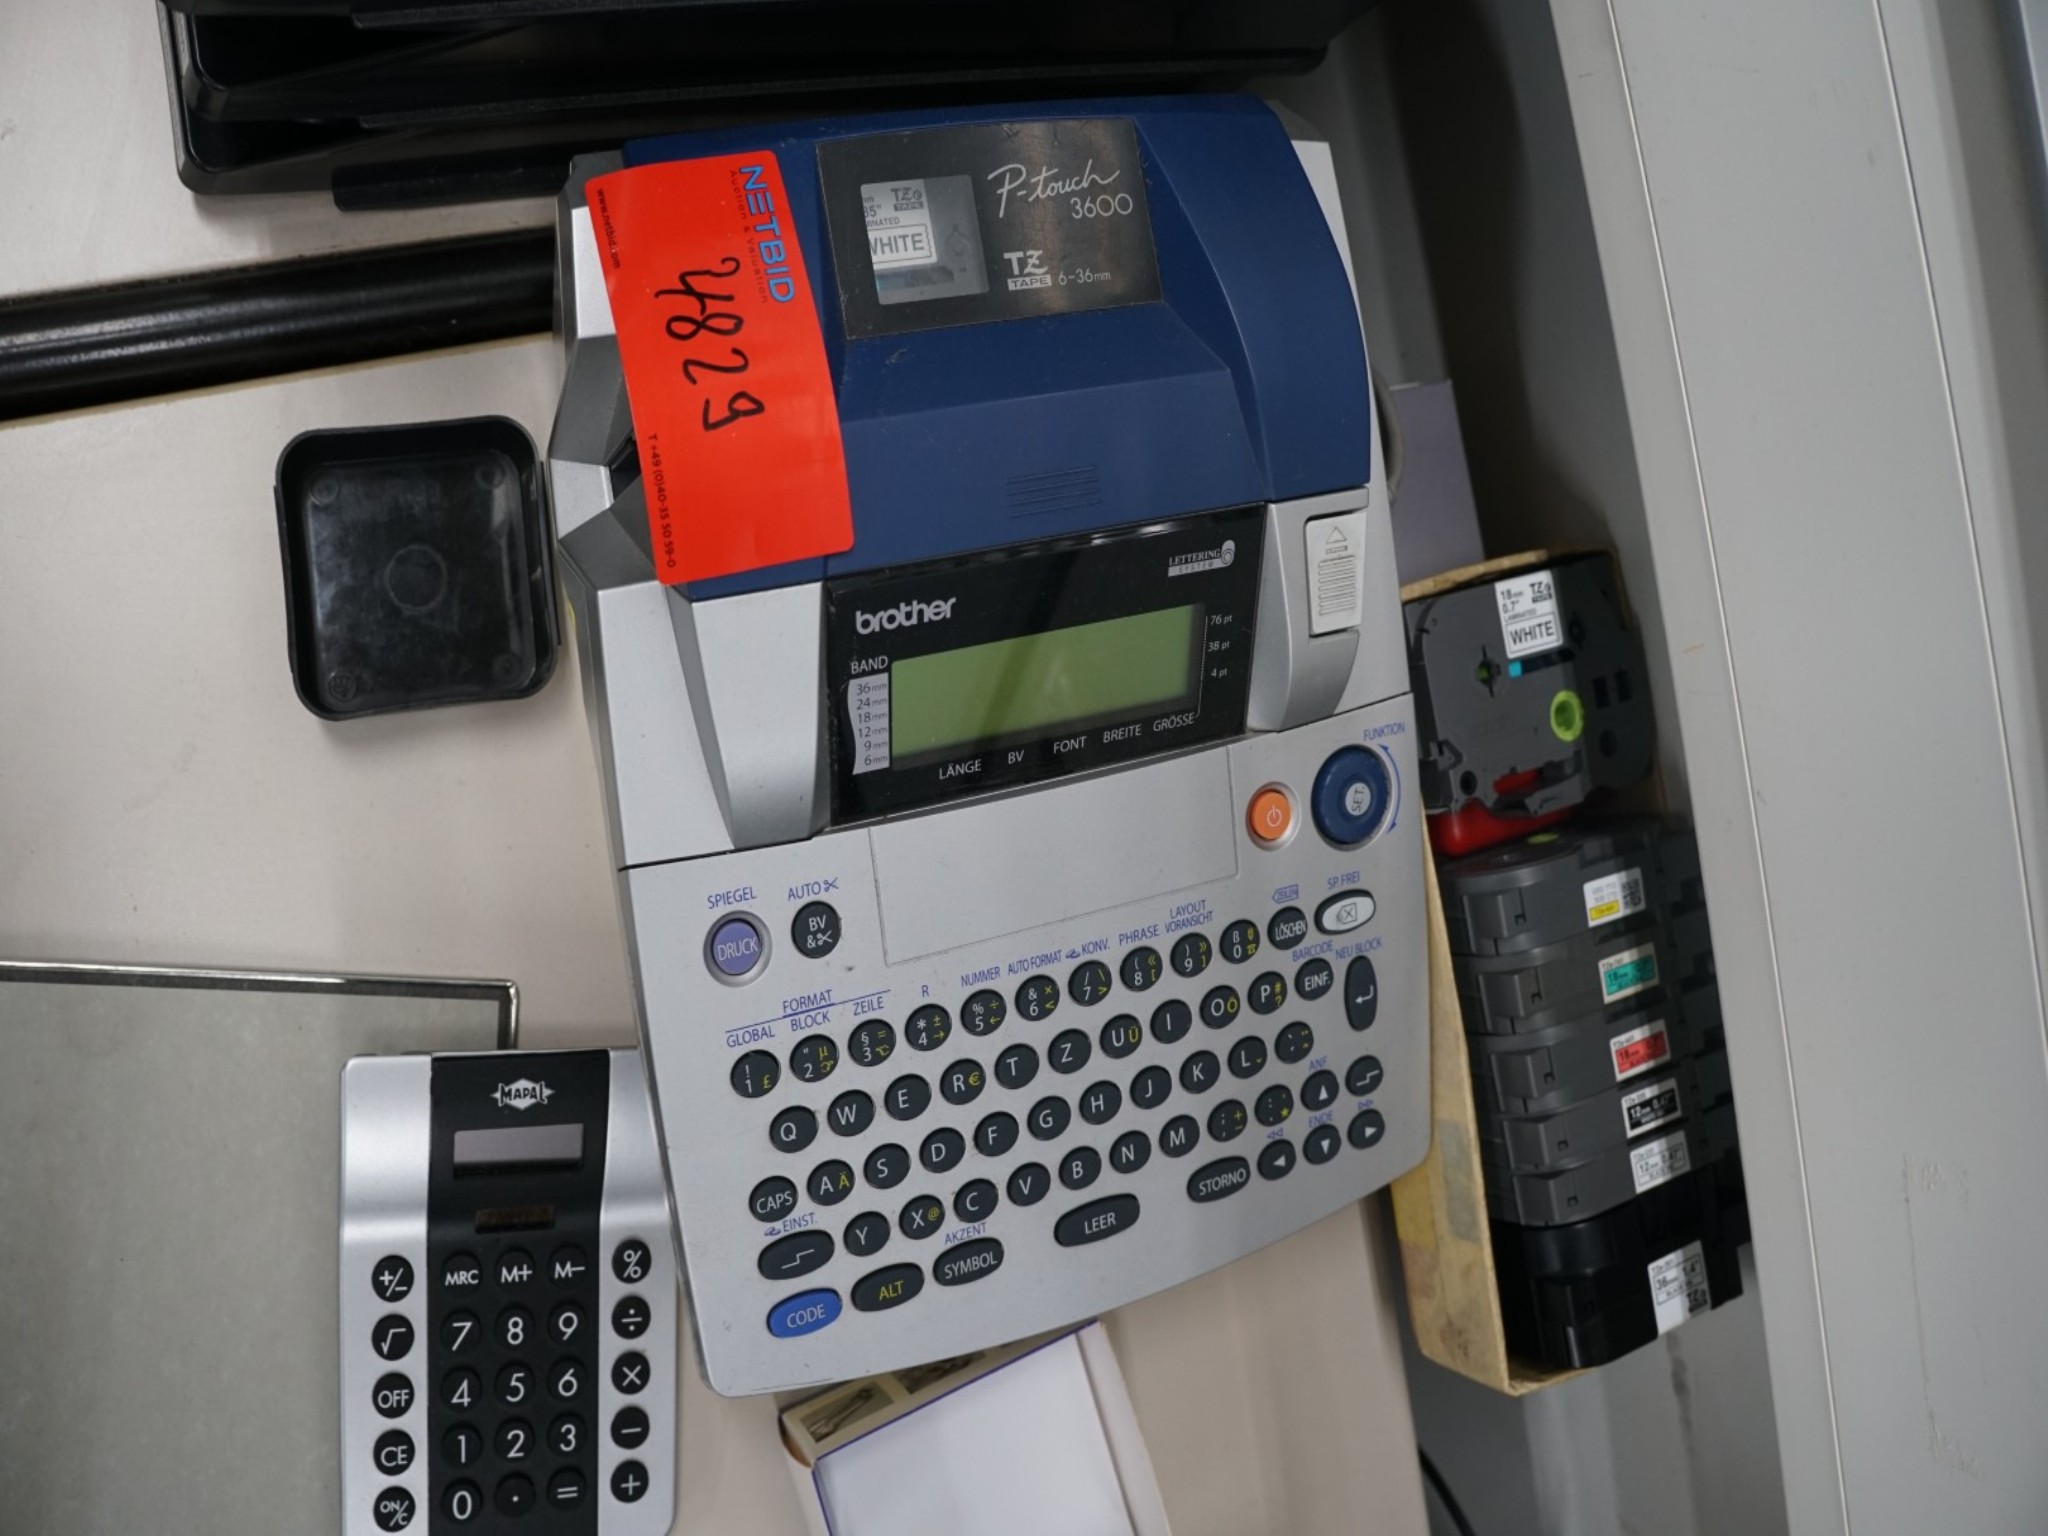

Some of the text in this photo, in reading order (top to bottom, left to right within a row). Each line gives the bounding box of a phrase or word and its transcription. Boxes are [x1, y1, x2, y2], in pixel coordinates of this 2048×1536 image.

[986, 159, 1120, 218] P-touch
[1070, 192, 1134, 219] 3600
[730, 170, 768, 303] Auction Valuation
[739, 165, 796, 303] NETBID
[1003, 250, 1048, 276] TZ
[1011, 275, 1049, 289] TAPE
[1058, 265, 1112, 285] 6-36mm
[650, 444, 662, 467] +49
[652, 469, 670, 522] (0)40-35
[661, 523, 672, 539] 50
[664, 540, 677, 568] 59-0
[1169, 547, 1222, 567] LETTERING
[855, 597, 957, 636] brother
[1210, 613, 1233, 625] 76 pt
[1510, 620, 1555, 646] WHITE
[1207, 639, 1231, 652] 38 pt
[851, 656, 888, 675] BAND
[1211, 666, 1229, 679] 4 pt
[1152, 710, 1195, 733] GRÖSSE
[1363, 721, 1406, 741] FUNKTION
[1102, 722, 1143, 744] BREITE
[1052, 735, 1087, 755] FONT
[1007, 750, 1025, 765] BV
[938, 758, 982, 780] LÄNGE
[707, 886, 757, 909] SPIEGEL
[788, 881, 821, 901] AUTO
[1170, 900, 1207, 920] LAYOUT
[809, 915, 826, 932] BV
[1164, 911, 1213, 934] VORANSICHT
[1118, 924, 1159, 946] PHRASE
[717, 937, 759, 962] DRUCK
[1081, 938, 1111, 957] KONV.
[1233, 945, 1241, 959] 0
[1292, 940, 1334, 962] BARCODE
[1335, 936, 1383, 961] NEU BLOCK
[1184, 959, 1193, 972] 9
[961, 966, 1000, 988] NUMMER
[1134, 972, 1143, 986] 8
[1304, 971, 1331, 991] EINF.
[783, 989, 833, 1014] FORMAT
[921, 985, 929, 998] R
[1083, 986, 1092, 1001] 7
[1260, 985, 1271, 1003] P
[853, 997, 885, 1016] ZEILE
[1029, 1002, 1039, 1016] 6
[1210, 998, 1225, 1016] O
[790, 1011, 831, 1032] BLOCK
[975, 1018, 984, 1032] 5
[726, 1025, 776, 1048] GLOBAL
[918, 1031, 928, 1045] 4
[1112, 1026, 1139, 1047] U Ü
[863, 1047, 872, 1062] 3
[1061, 1043, 1072, 1063] Z
[1241, 1050, 1251, 1068] L
[804, 1064, 814, 1079] 2
[1006, 1057, 1019, 1076] T
[1192, 1063, 1204, 1082] K
[953, 1074, 965, 1093] R
[1145, 1079, 1153, 1098] J
[499, 1082, 546, 1106] MAPAL
[898, 1089, 909, 1108] E
[1091, 1094, 1104, 1114] H
[837, 1104, 857, 1126] W
[1039, 1110, 1053, 1129] G
[1309, 1111, 1333, 1128] ENDE
[780, 1121, 797, 1142] Q
[987, 1126, 998, 1145] F
[1169, 1127, 1186, 1148] M
[931, 1143, 946, 1162] D
[1121, 1144, 1135, 1163] N
[877, 1158, 888, 1178] S
[1072, 1161, 1083, 1179] B
[819, 1171, 850, 1195] A Ä
[1018, 1176, 1032, 1195] V
[1199, 1168, 1247, 1196] STORNO
[756, 1191, 793, 1214] CAPS
[966, 1192, 979, 1210] C
[782, 1213, 817, 1233] EINST.
[911, 1210, 925, 1229] X
[1084, 1212, 1116, 1235] LEER
[855, 1226, 868, 1245] Y
[944, 1223, 988, 1246] AKZENT
[501, 1263, 533, 1284] M+
[623, 1249, 642, 1279] %
[943, 1251, 998, 1279] SYMBOL
[445, 1269, 479, 1287] MRC
[879, 1281, 904, 1300] ALT
[558, 1312, 578, 1340] 9
[787, 1304, 827, 1328] CODE
[452, 1321, 473, 1351] 7
[507, 1317, 524, 1345] 8
[506, 1373, 525, 1402] 5
[558, 1368, 578, 1396] 6
[378, 1389, 410, 1409] OFF
[451, 1378, 471, 1407] 4
[507, 1430, 525, 1458] 2
[560, 1424, 576, 1451] 3
[381, 1446, 408, 1467] CE
[457, 1435, 466, 1463] 1
[452, 1491, 472, 1520] 0
